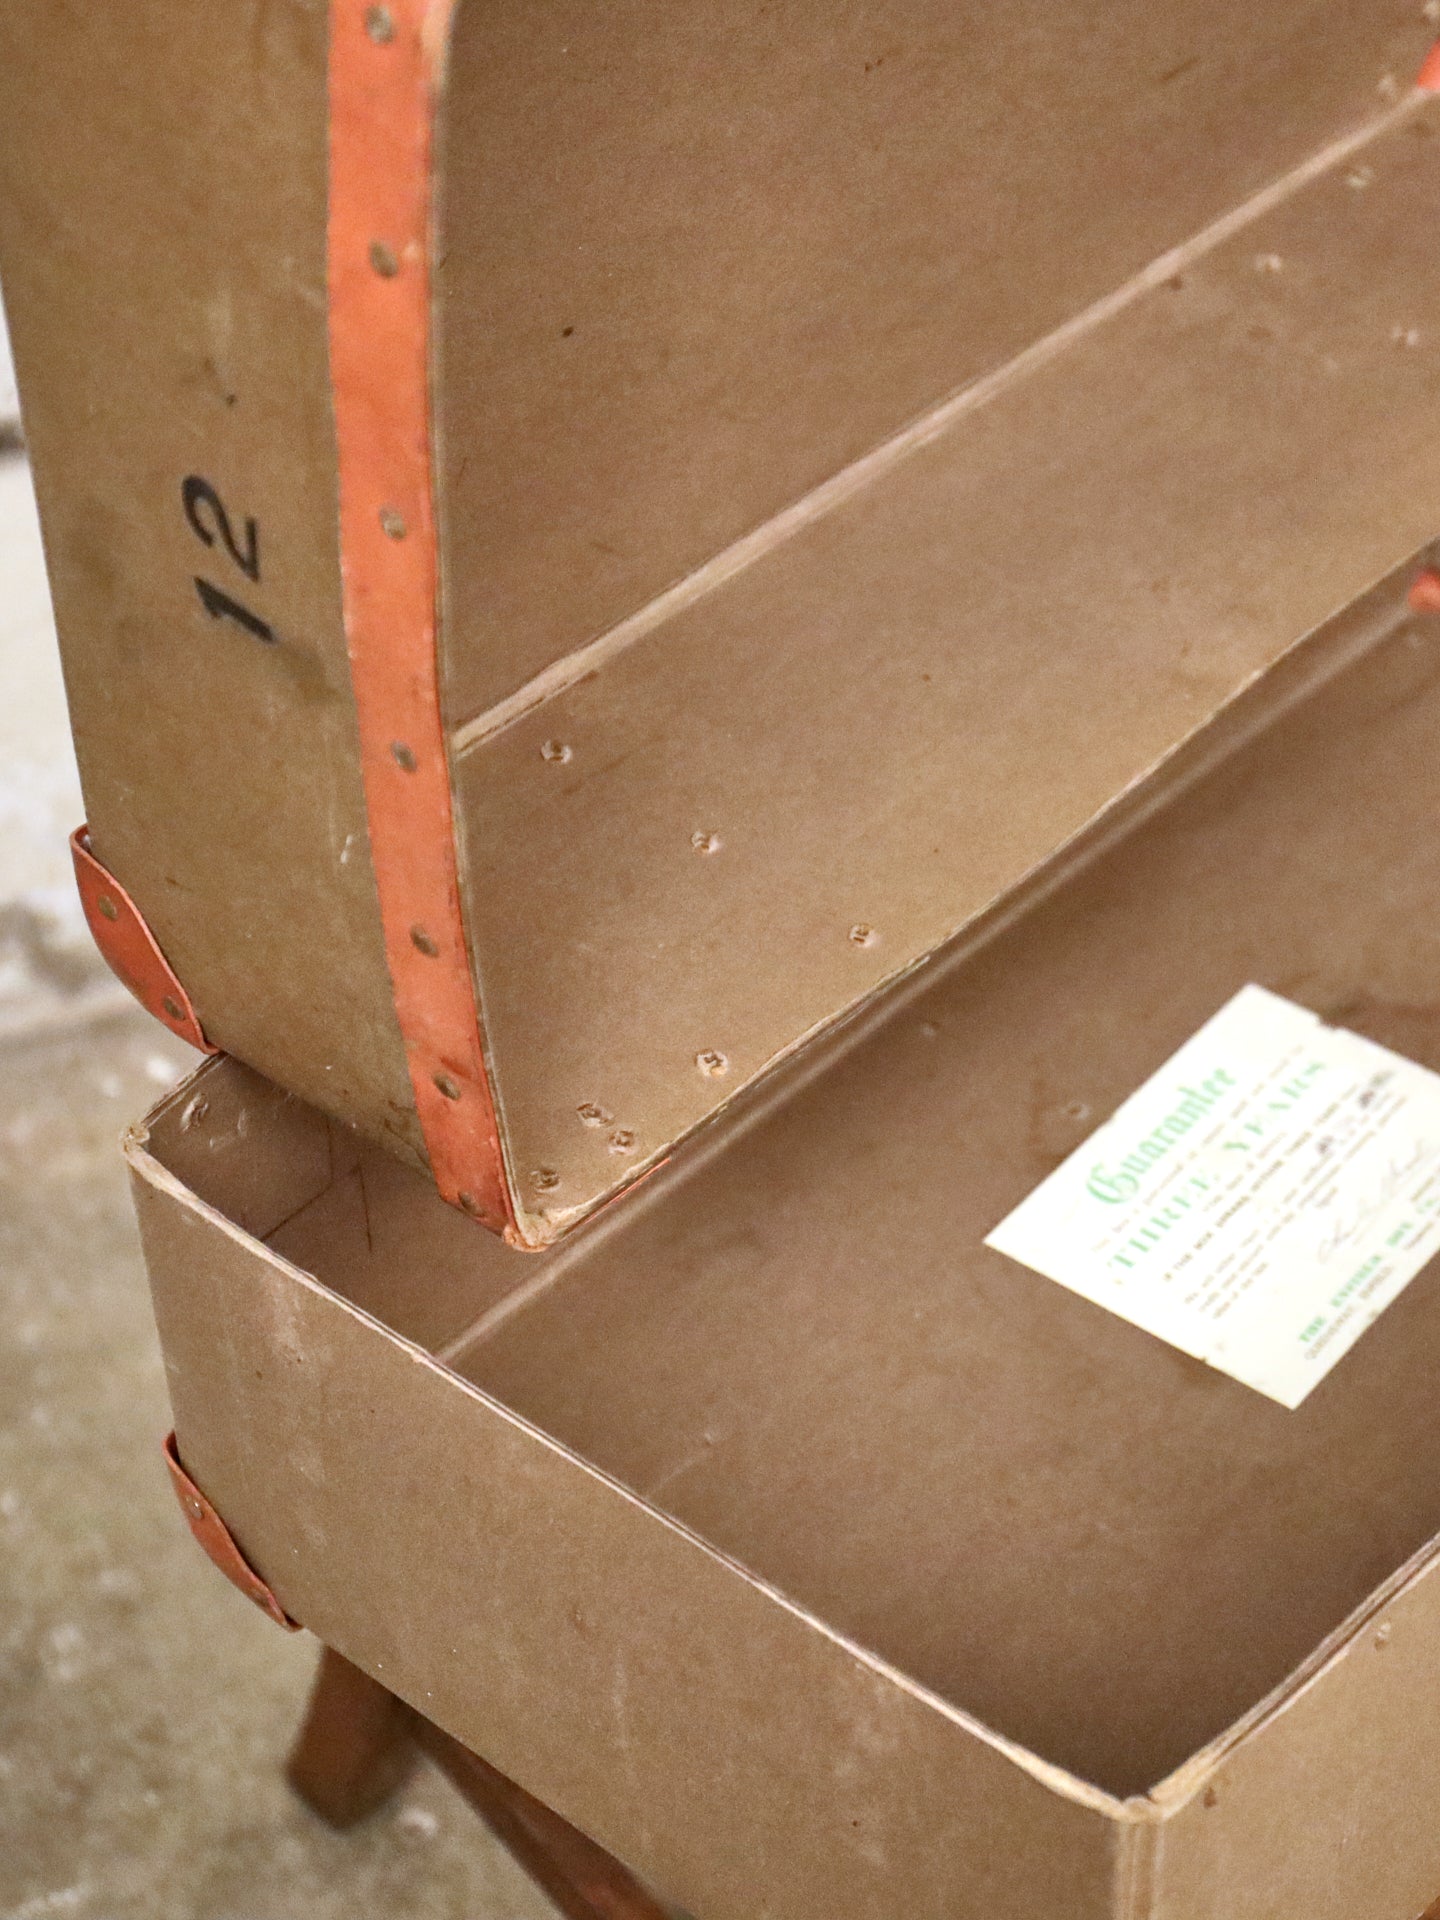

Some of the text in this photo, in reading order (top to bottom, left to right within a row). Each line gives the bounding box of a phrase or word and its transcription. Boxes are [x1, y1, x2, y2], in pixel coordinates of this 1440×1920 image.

[182, 475, 278, 645] 12
[1086, 1067, 1237, 1205] Guarantee
[1107, 1168, 1221, 1270] THREE
[1221, 1060, 1327, 1153] YEARS
